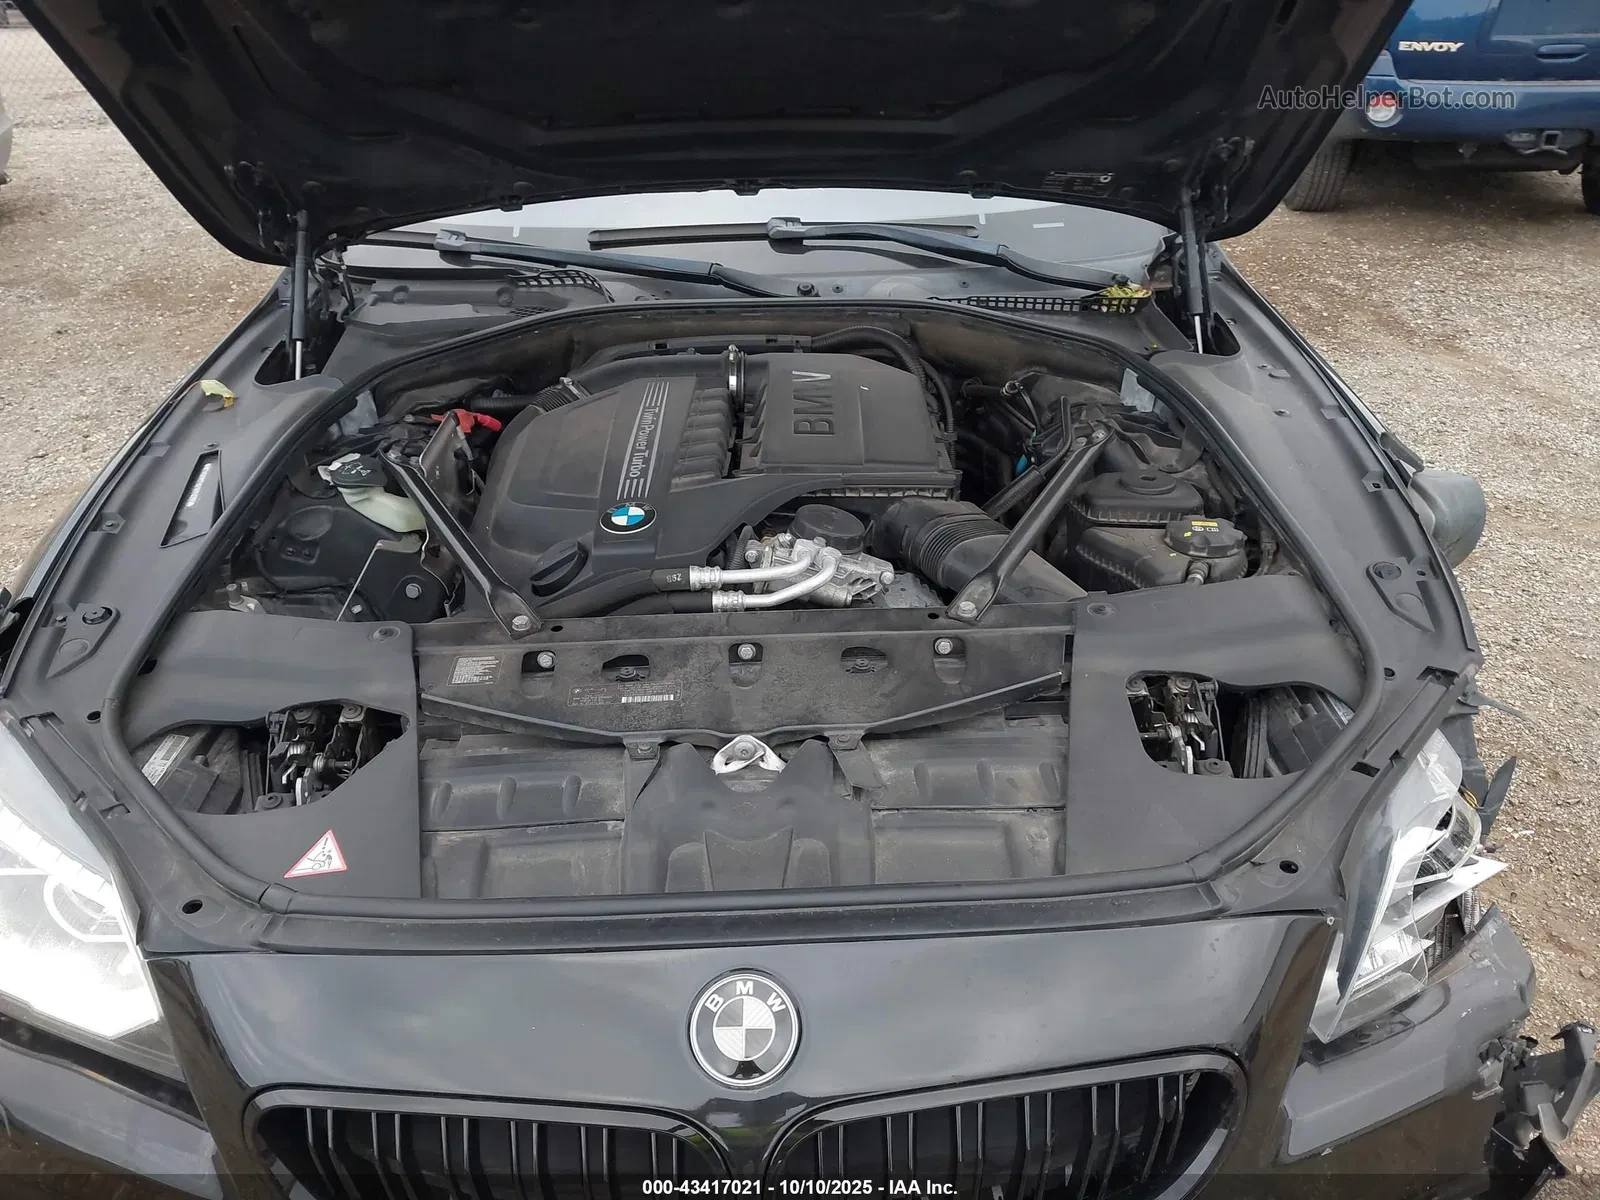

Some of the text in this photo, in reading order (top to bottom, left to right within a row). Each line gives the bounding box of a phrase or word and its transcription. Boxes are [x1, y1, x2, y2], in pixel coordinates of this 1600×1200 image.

[1398, 41, 1465, 52] ENVOY
[792, 370, 834, 436] BMW
[629, 407, 659, 478] TwinPower Turbo
[705, 981, 786, 1013] BMW
